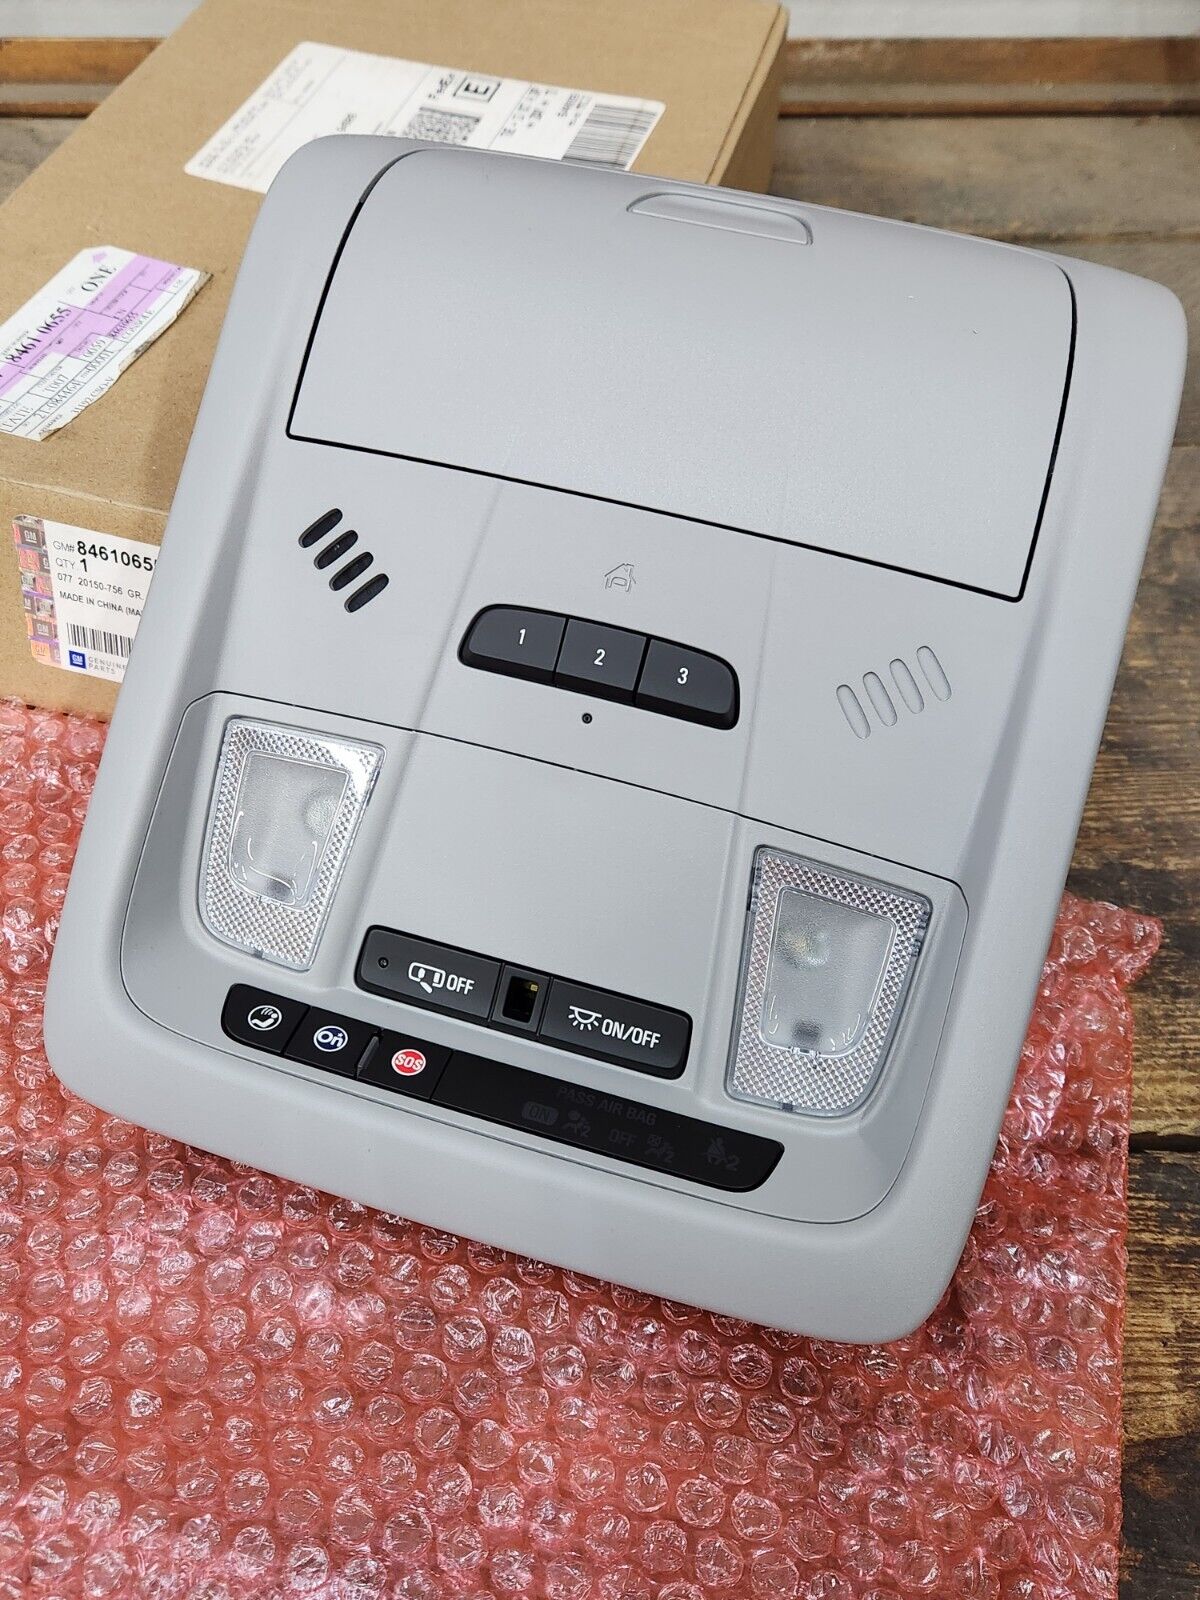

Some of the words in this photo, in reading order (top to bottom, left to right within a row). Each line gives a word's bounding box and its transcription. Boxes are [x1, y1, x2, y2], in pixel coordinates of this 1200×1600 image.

[81, 265, 118, 292] ONE
[5, 336, 42, 362] 8461
[36, 307, 72, 334] 0655
[53, 540, 75, 553] GM#
[77, 540, 157, 572] 8461065
[55, 557, 76, 570] QTY
[80, 558, 88, 573] 1
[57, 572, 73, 583] 077
[78, 577, 123, 596] 20150-756
[59, 591, 84, 604] MADE
[86, 597, 95, 606] IN
[98, 600, 124, 613] CHINA
[88, 662, 117, 675] PARTS
[518, 628, 527, 645] 1
[593, 648, 607, 666] 2
[676, 667, 690, 685] 3
[446, 973, 475, 995] OFF
[601, 1017, 661, 1049] ON/OFF
[394, 1053, 424, 1071] SOS
[557, 1086, 595, 1107] PASS
[597, 1098, 624, 1117] AIR
[626, 1107, 657, 1127] BAG
[608, 1127, 640, 1148] OFF
